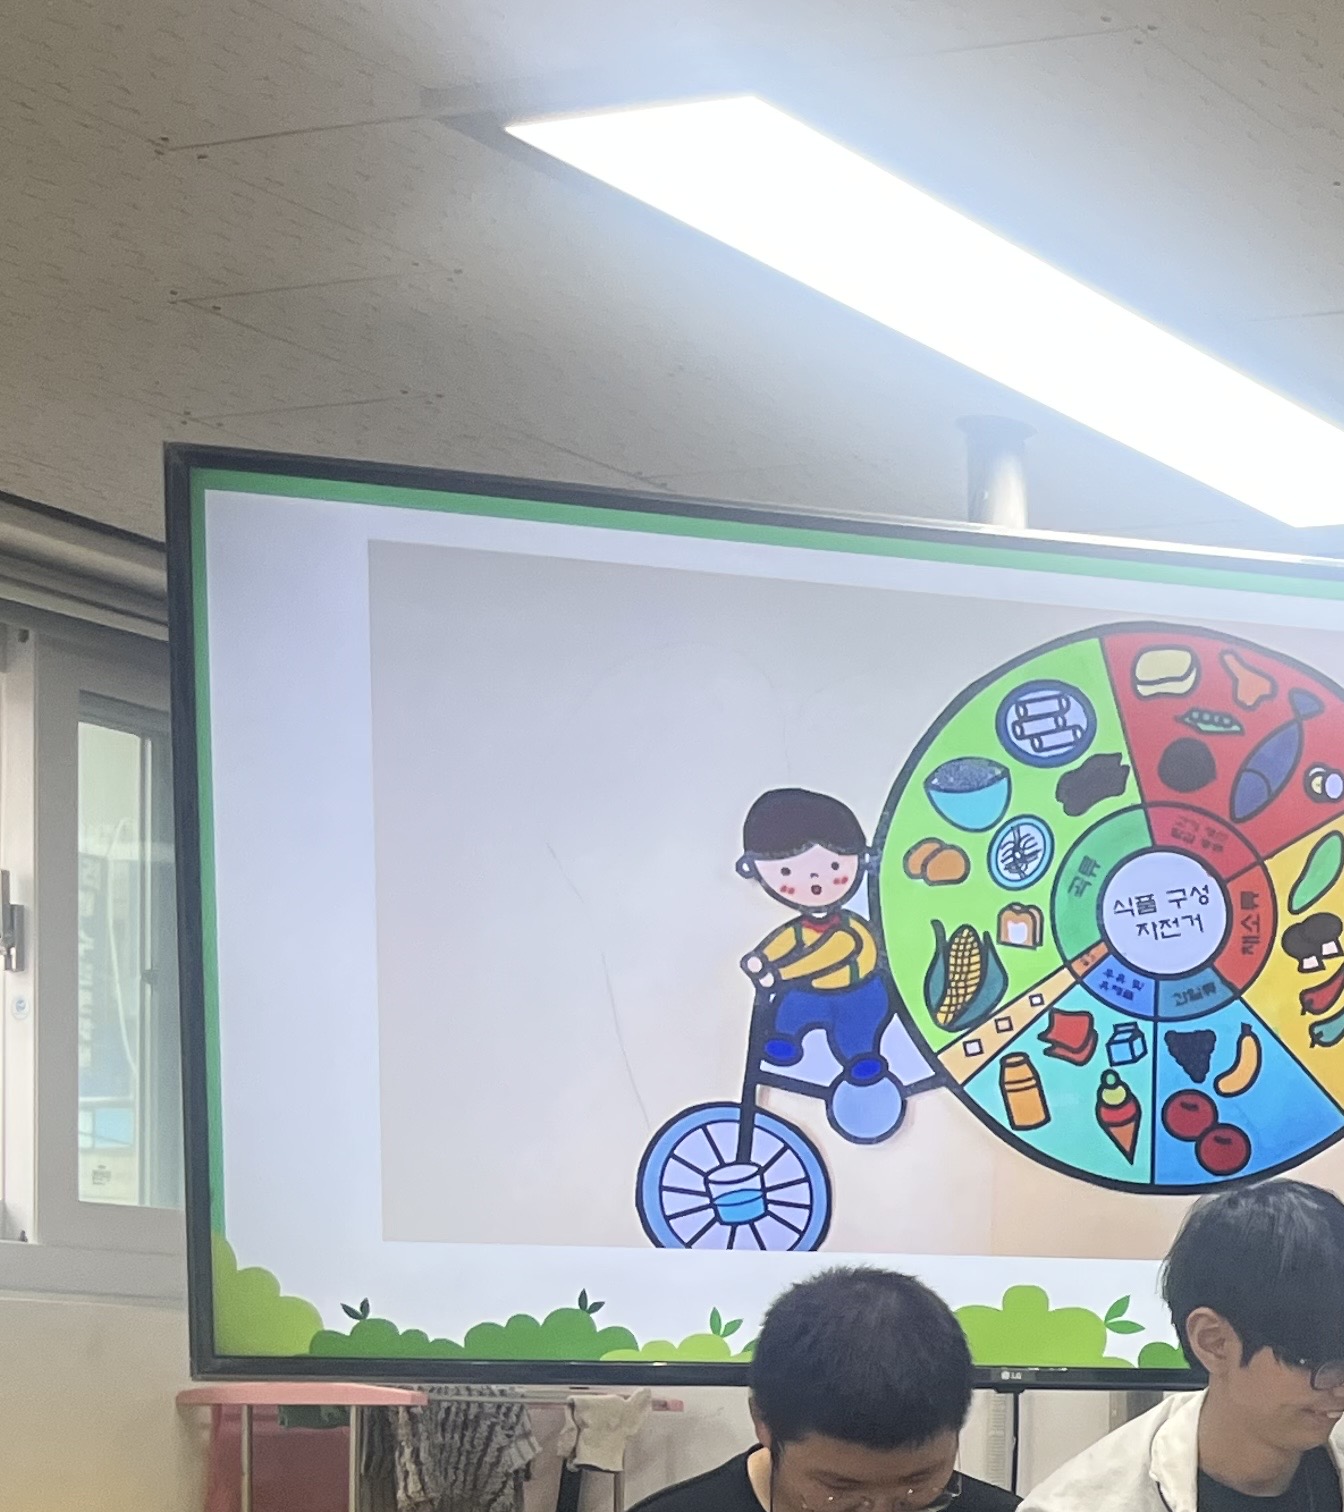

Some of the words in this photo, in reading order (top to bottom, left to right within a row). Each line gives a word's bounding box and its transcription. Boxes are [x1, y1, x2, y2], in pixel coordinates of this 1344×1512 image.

[1113, 894, 1157, 917] 식품
[1166, 884, 1210, 909] 구성
[1136, 914, 1204, 940] 자전거
